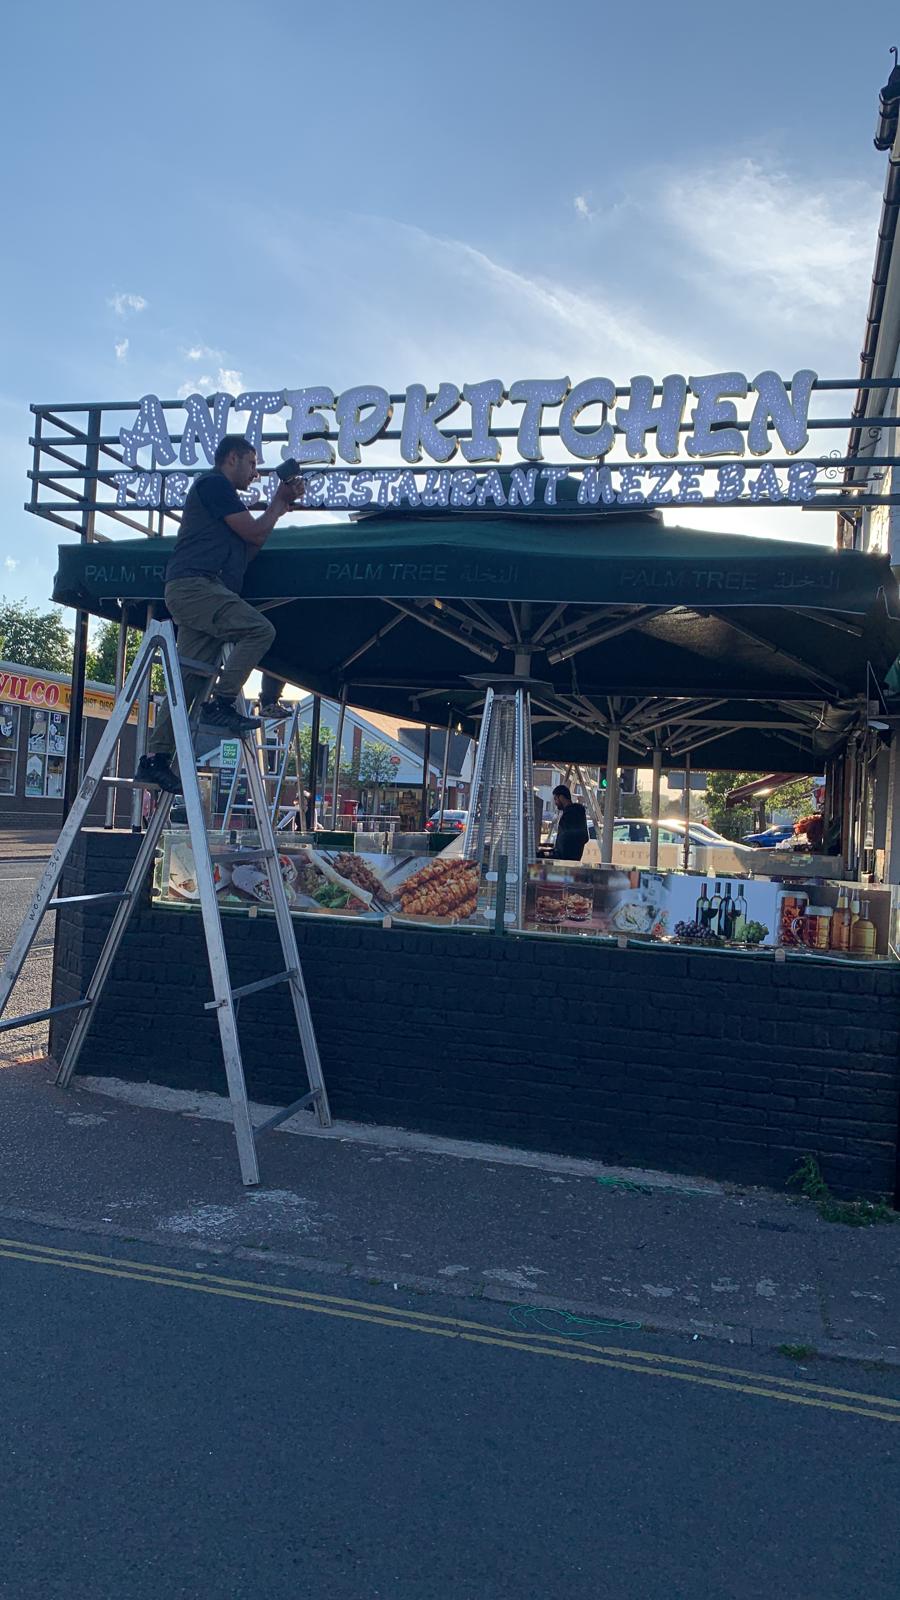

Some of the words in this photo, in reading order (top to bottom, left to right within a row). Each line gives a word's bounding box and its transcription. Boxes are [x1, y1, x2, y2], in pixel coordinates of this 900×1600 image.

[577, 464, 705, 505] MEZE
[713, 461, 819, 503] BAR
[84, 564, 136, 583] PALM
[141, 564, 167, 582] TR
[325, 563, 384, 581] PALM
[389, 563, 449, 582] TREE
[620, 568, 684, 588] PALM
[691, 570, 760, 591] TREE
